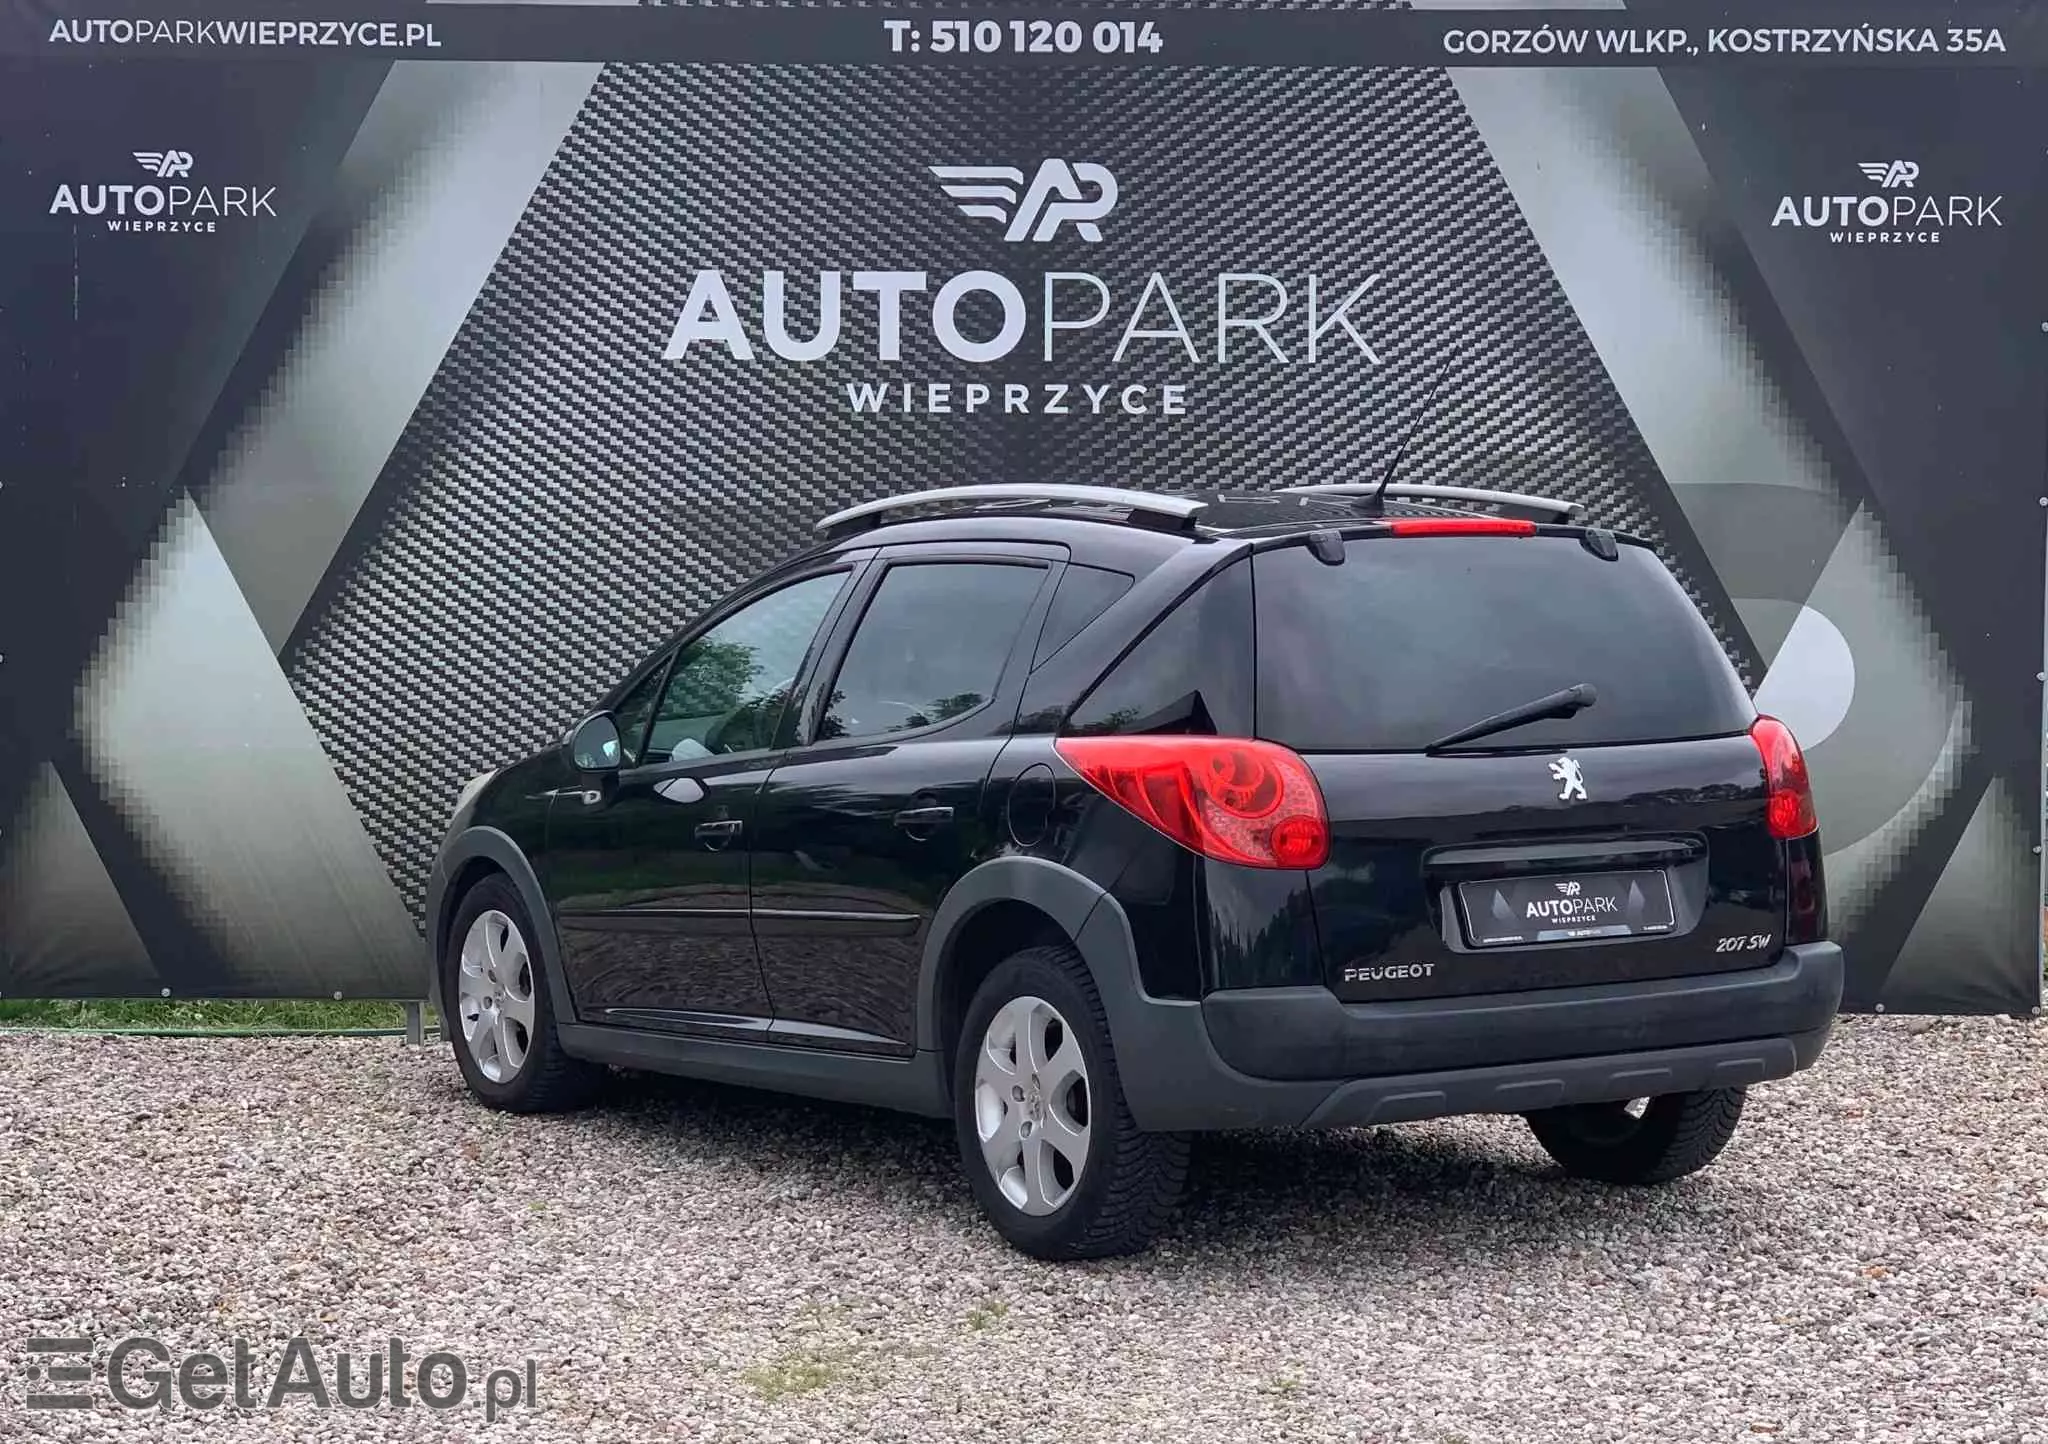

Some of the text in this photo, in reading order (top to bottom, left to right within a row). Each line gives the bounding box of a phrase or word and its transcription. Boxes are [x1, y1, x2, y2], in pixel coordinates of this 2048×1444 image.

[48, 19, 443, 48] AUTOPARKWIEPRZYCE.PL
[883, 20, 1164, 54] T: 510 120 014
[1443, 23, 2007, 57] GORZÓW WLKP., KOSTRZYŃSKA 35A
[49, 184, 277, 217] AUTOPARK
[1771, 195, 2002, 227] AUTOPARK
[107, 220, 216, 233] WIEPRZYCE
[1829, 231, 1940, 243] WIEPRZYCE
[662, 270, 1382, 365] AUTOPARK
[846, 383, 1187, 416] WIEPRZYCE
[1526, 896, 1618, 918] AUTOPARK
[1716, 934, 1772, 952] 207 SW
[1344, 963, 1435, 982] PEUGEOT
